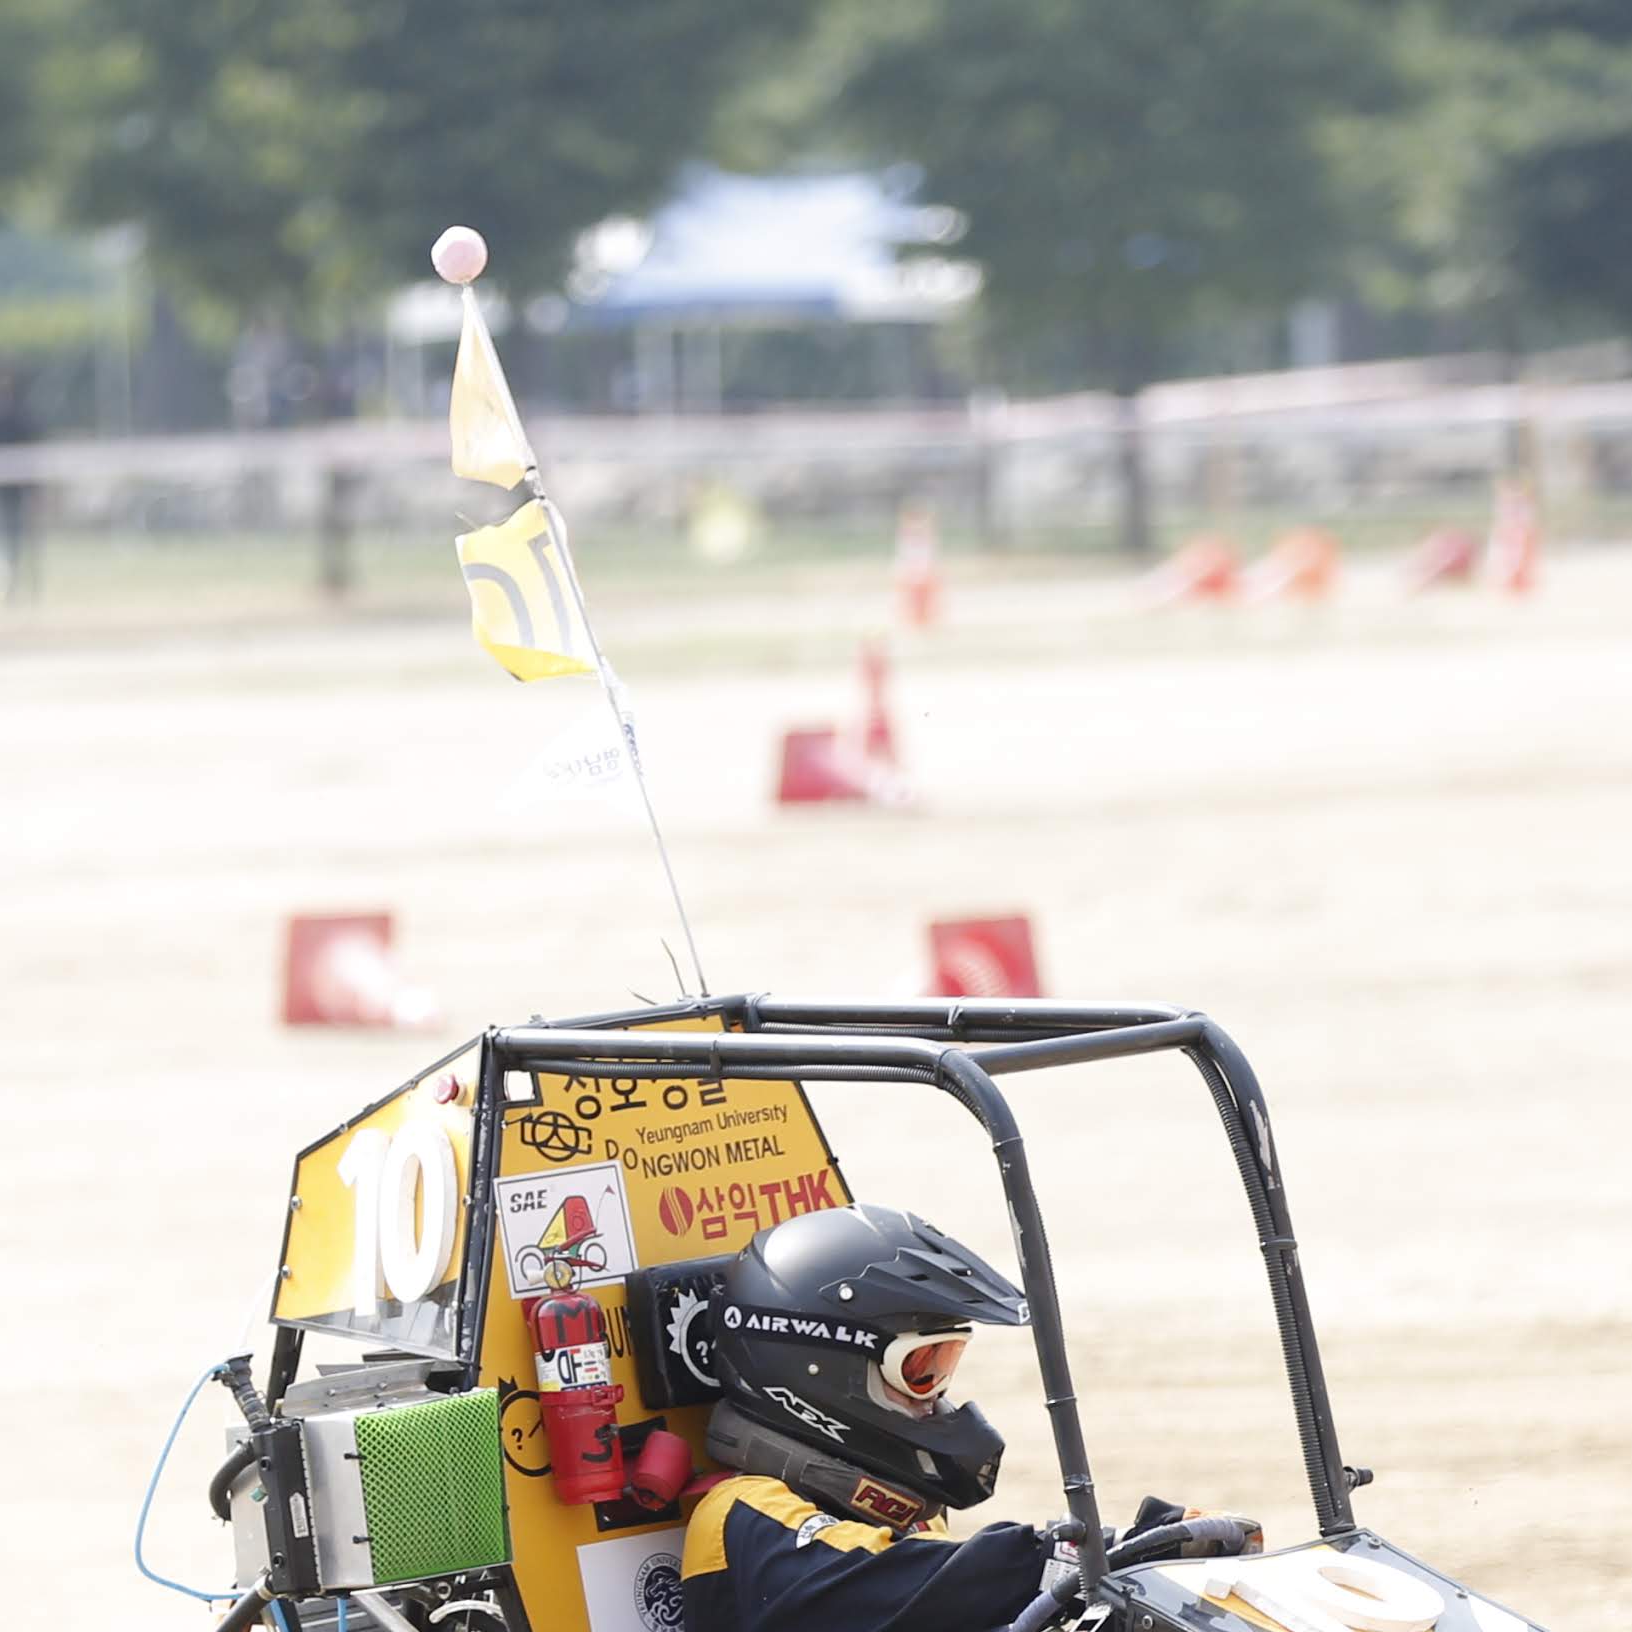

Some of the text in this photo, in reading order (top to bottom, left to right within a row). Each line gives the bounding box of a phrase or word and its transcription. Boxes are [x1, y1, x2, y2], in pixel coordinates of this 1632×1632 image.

[635, 1103, 788, 1146] Yeungnam University
[726, 1135, 785, 1158] METAL
[337, 1120, 458, 1318] 10
[510, 1189, 548, 1213] SAE
[745, 1313, 879, 1349] AIRWALK
